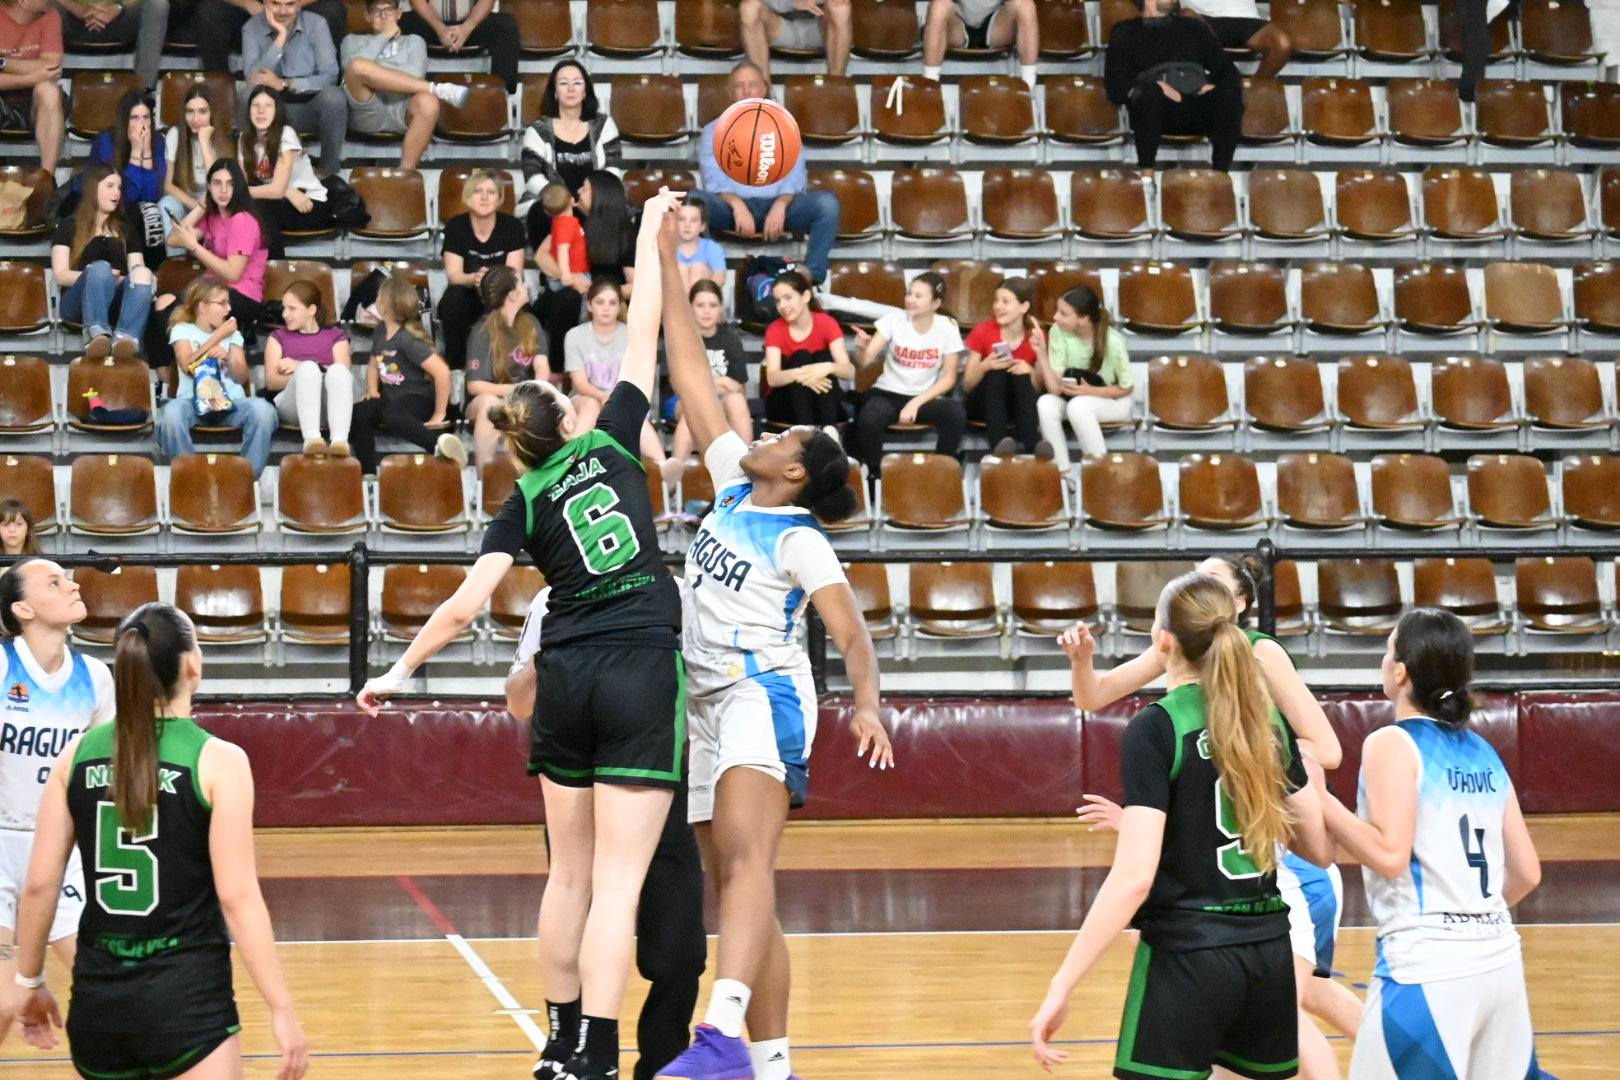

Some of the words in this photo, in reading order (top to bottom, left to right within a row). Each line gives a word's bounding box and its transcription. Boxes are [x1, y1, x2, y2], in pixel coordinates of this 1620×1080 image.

[563, 482, 641, 575] 6
[690, 528, 752, 592] AGUSA
[95, 800, 160, 916] 5
[1458, 813, 1493, 899] 4
